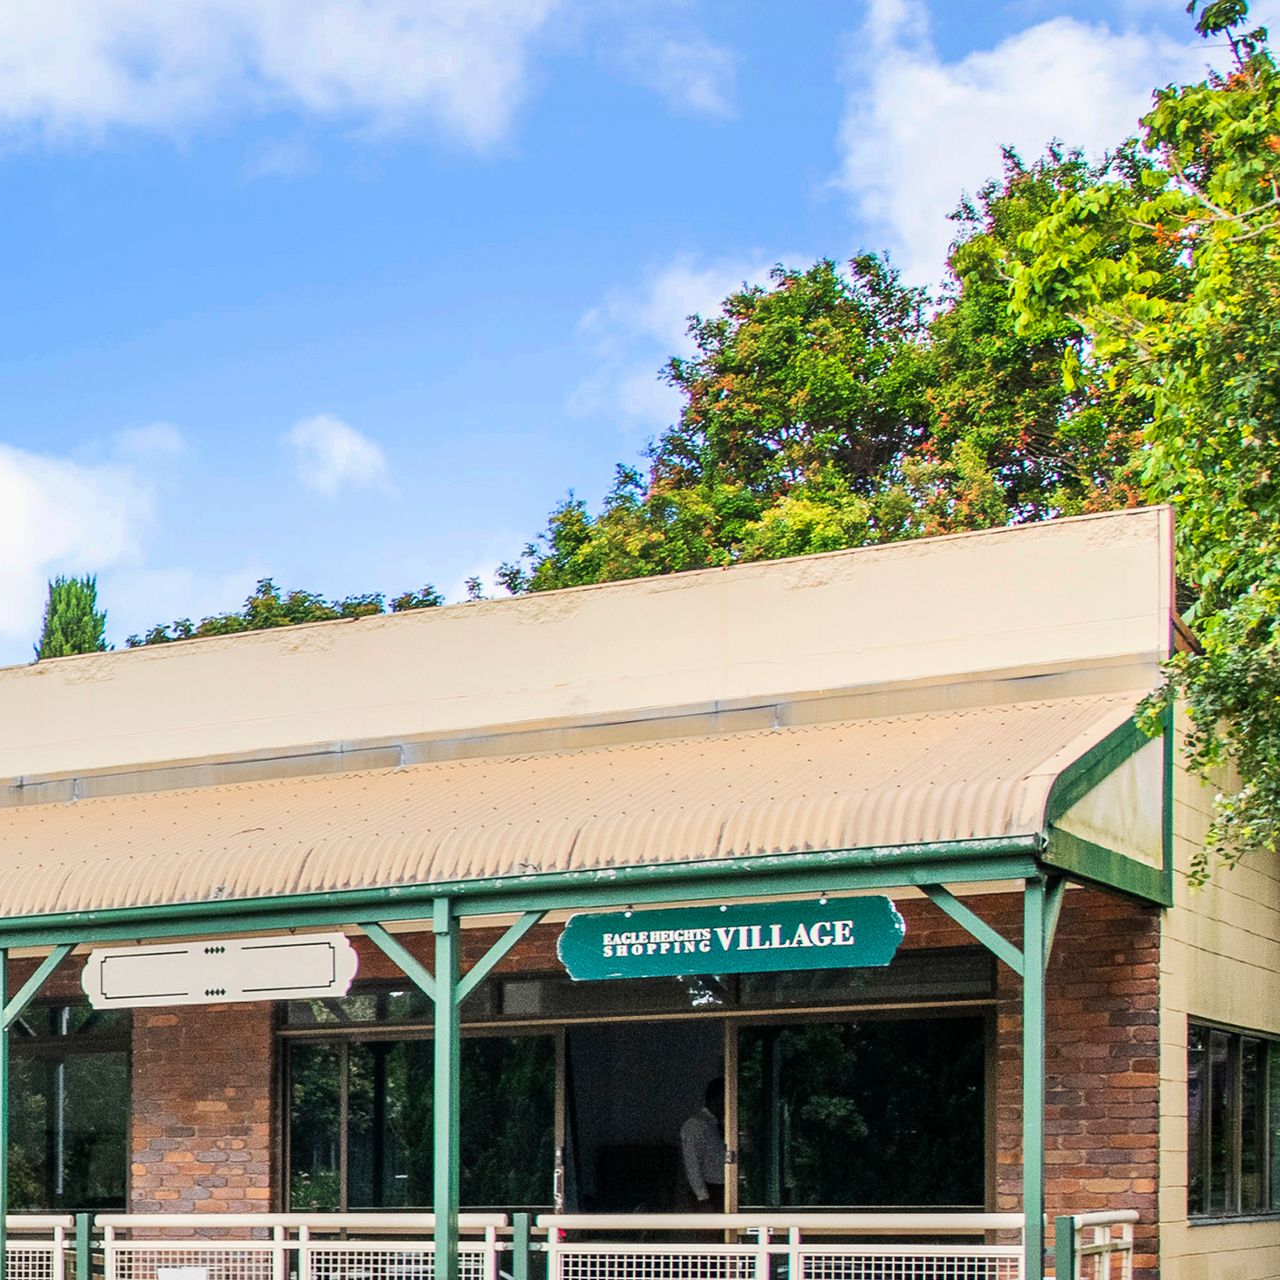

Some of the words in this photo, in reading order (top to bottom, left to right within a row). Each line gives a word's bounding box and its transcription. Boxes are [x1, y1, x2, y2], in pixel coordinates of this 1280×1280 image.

[603, 932, 649, 945] EAGLE
[650, 928, 711, 942] HEIGHTS
[713, 920, 855, 951] VILLAGE
[603, 941, 711, 958] SHOPPING
